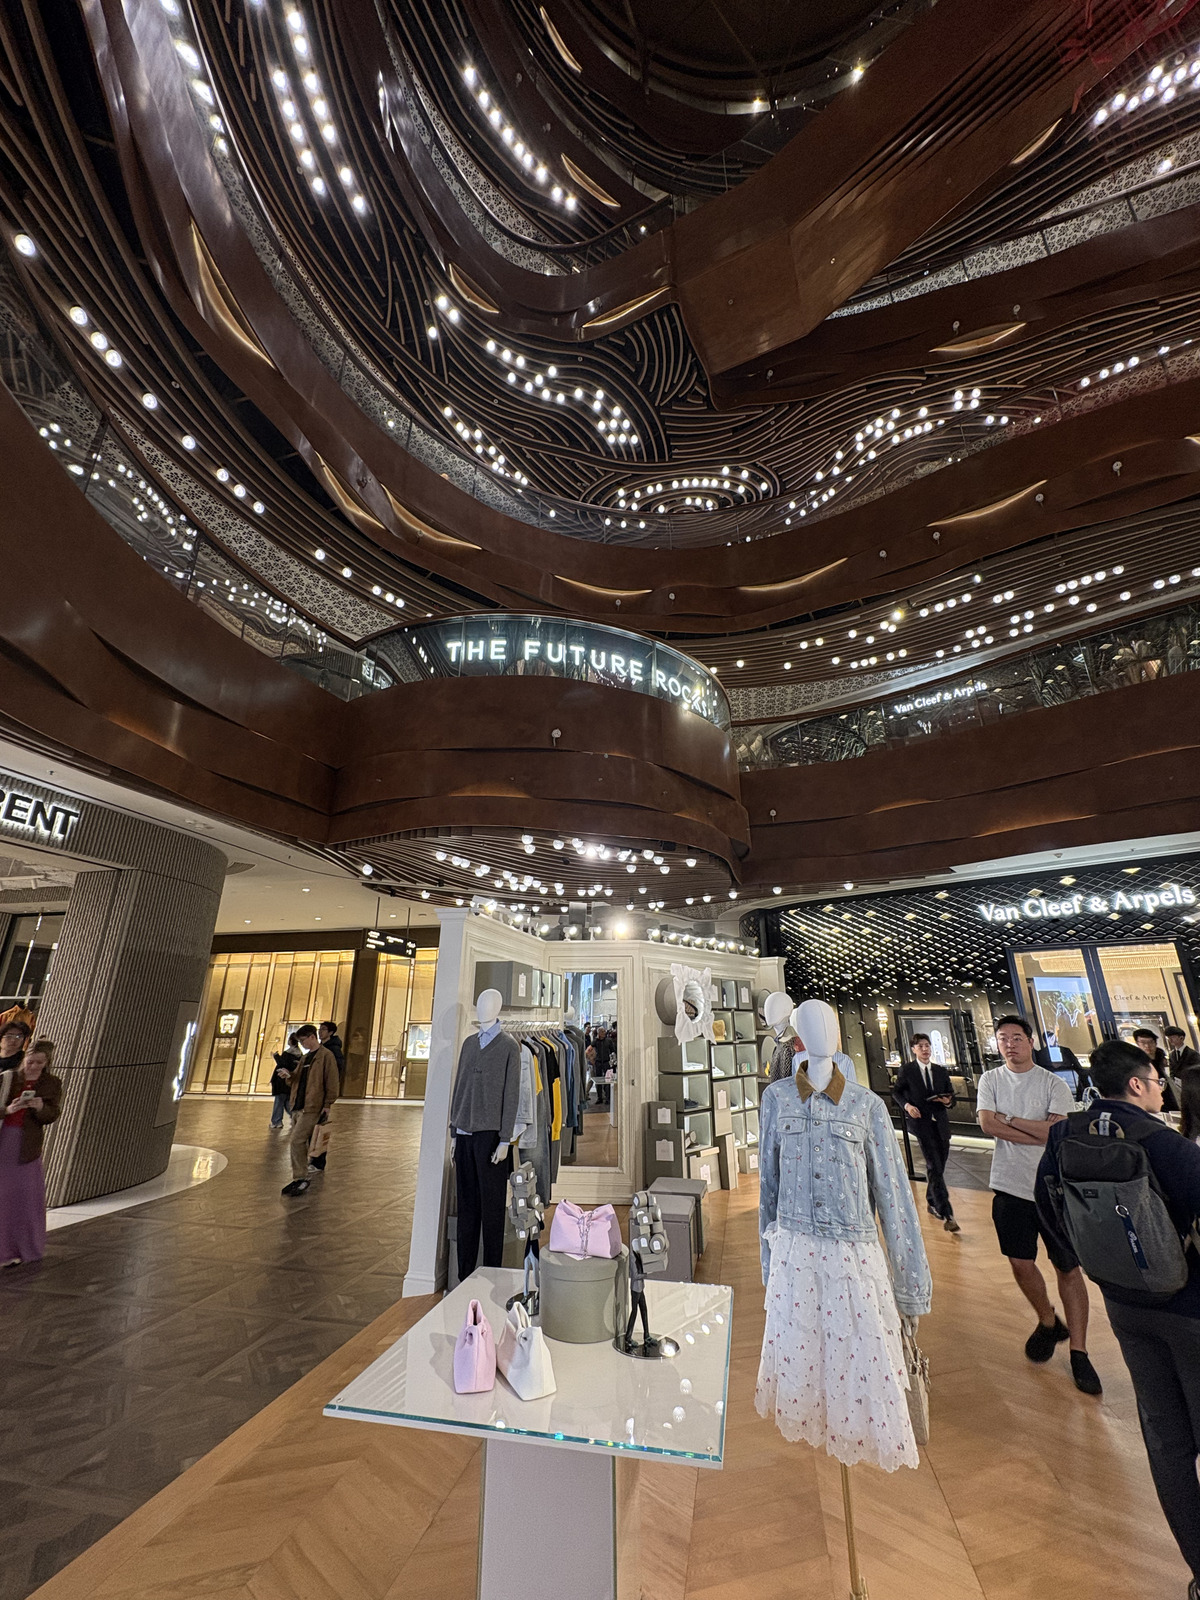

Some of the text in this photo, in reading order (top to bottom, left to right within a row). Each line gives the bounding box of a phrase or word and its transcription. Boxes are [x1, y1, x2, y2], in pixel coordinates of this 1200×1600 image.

[447, 640, 507, 662] THE
[524, 641, 643, 682] FUTURE
[894, 703, 914, 713] Van
[915, 692, 942, 708] Cleef
[943, 692, 952, 700] &
[979, 884, 1196, 921] Van Cleef & Arpels
[1142, 994, 1166, 1002] Arpels
